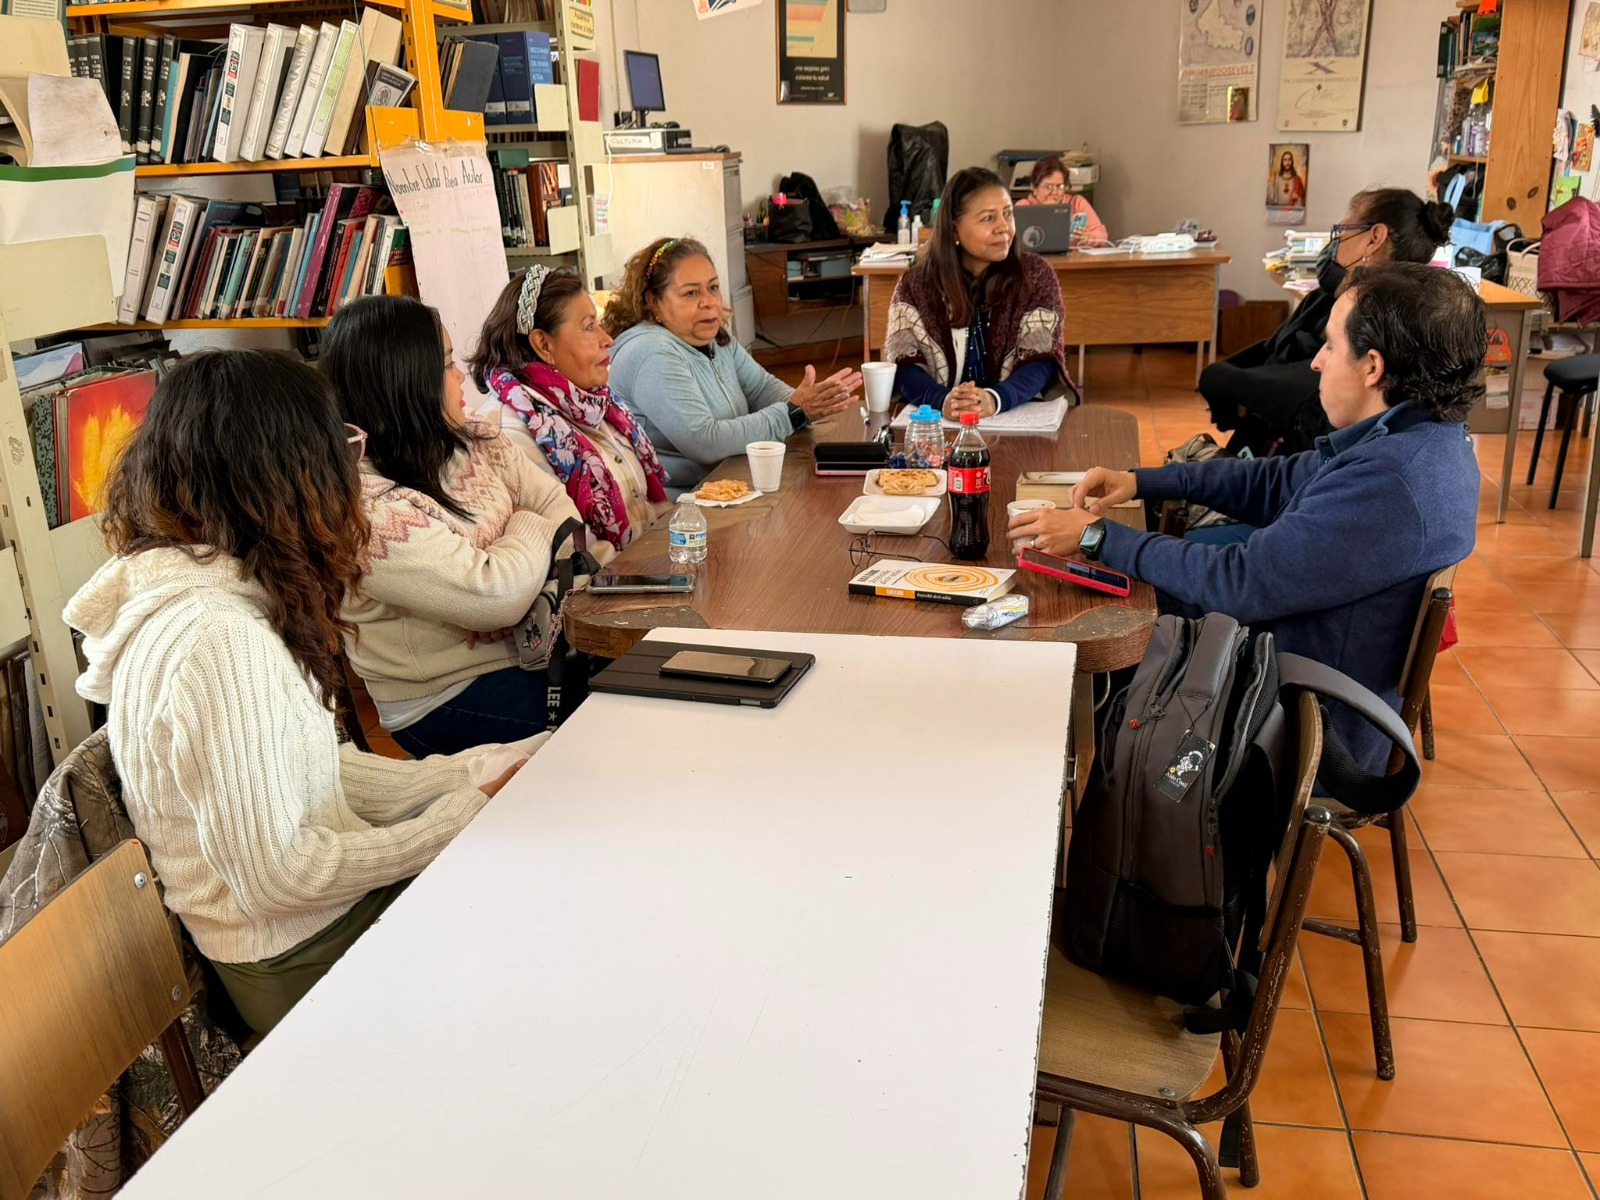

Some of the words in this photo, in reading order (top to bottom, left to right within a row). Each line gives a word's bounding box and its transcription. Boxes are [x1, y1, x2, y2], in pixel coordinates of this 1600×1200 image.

[385, 167, 421, 196] Nombre
[415, 162, 441, 190] Edad
[461, 159, 483, 185] Autor
[547, 686, 561, 707] LEE
